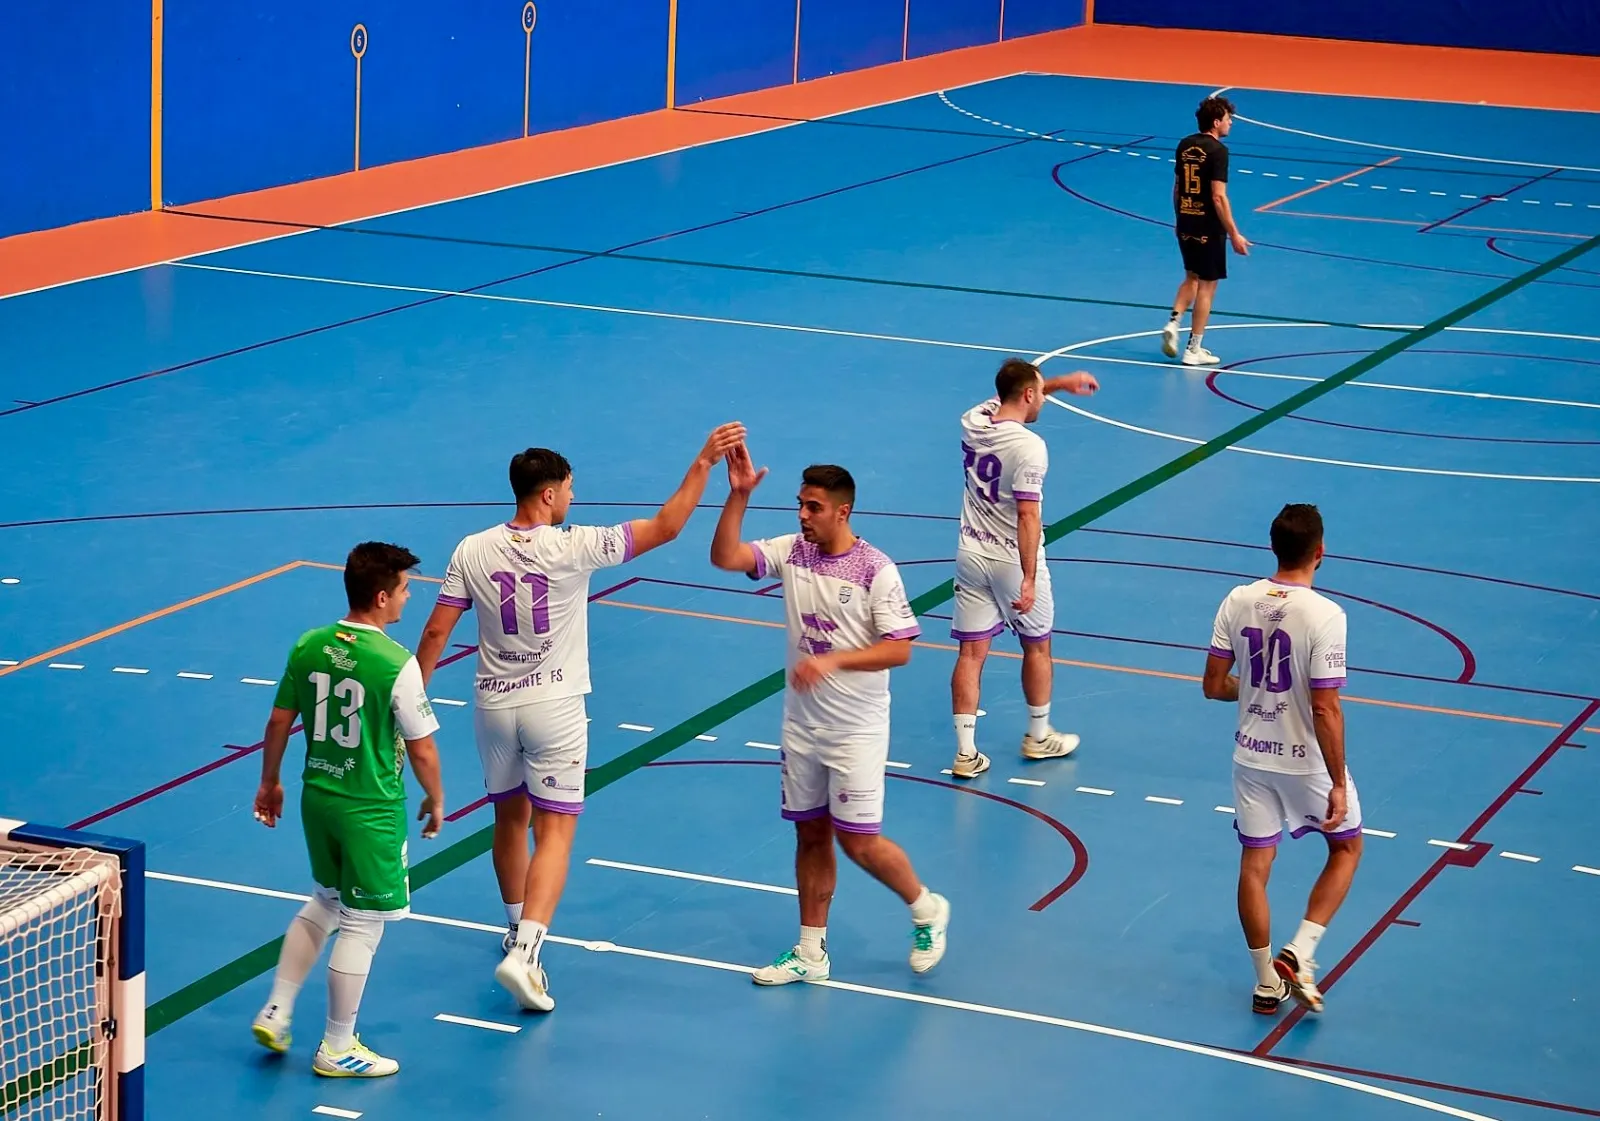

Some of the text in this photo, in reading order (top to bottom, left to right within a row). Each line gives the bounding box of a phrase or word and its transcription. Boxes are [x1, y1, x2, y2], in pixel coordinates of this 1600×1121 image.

[1183, 163, 1201, 193] 15
[489, 570, 550, 635] 11
[550, 668, 563, 683] FS
[1240, 625, 1293, 694] 10
[307, 670, 366, 749] 13
[1292, 744, 1306, 758] FS
